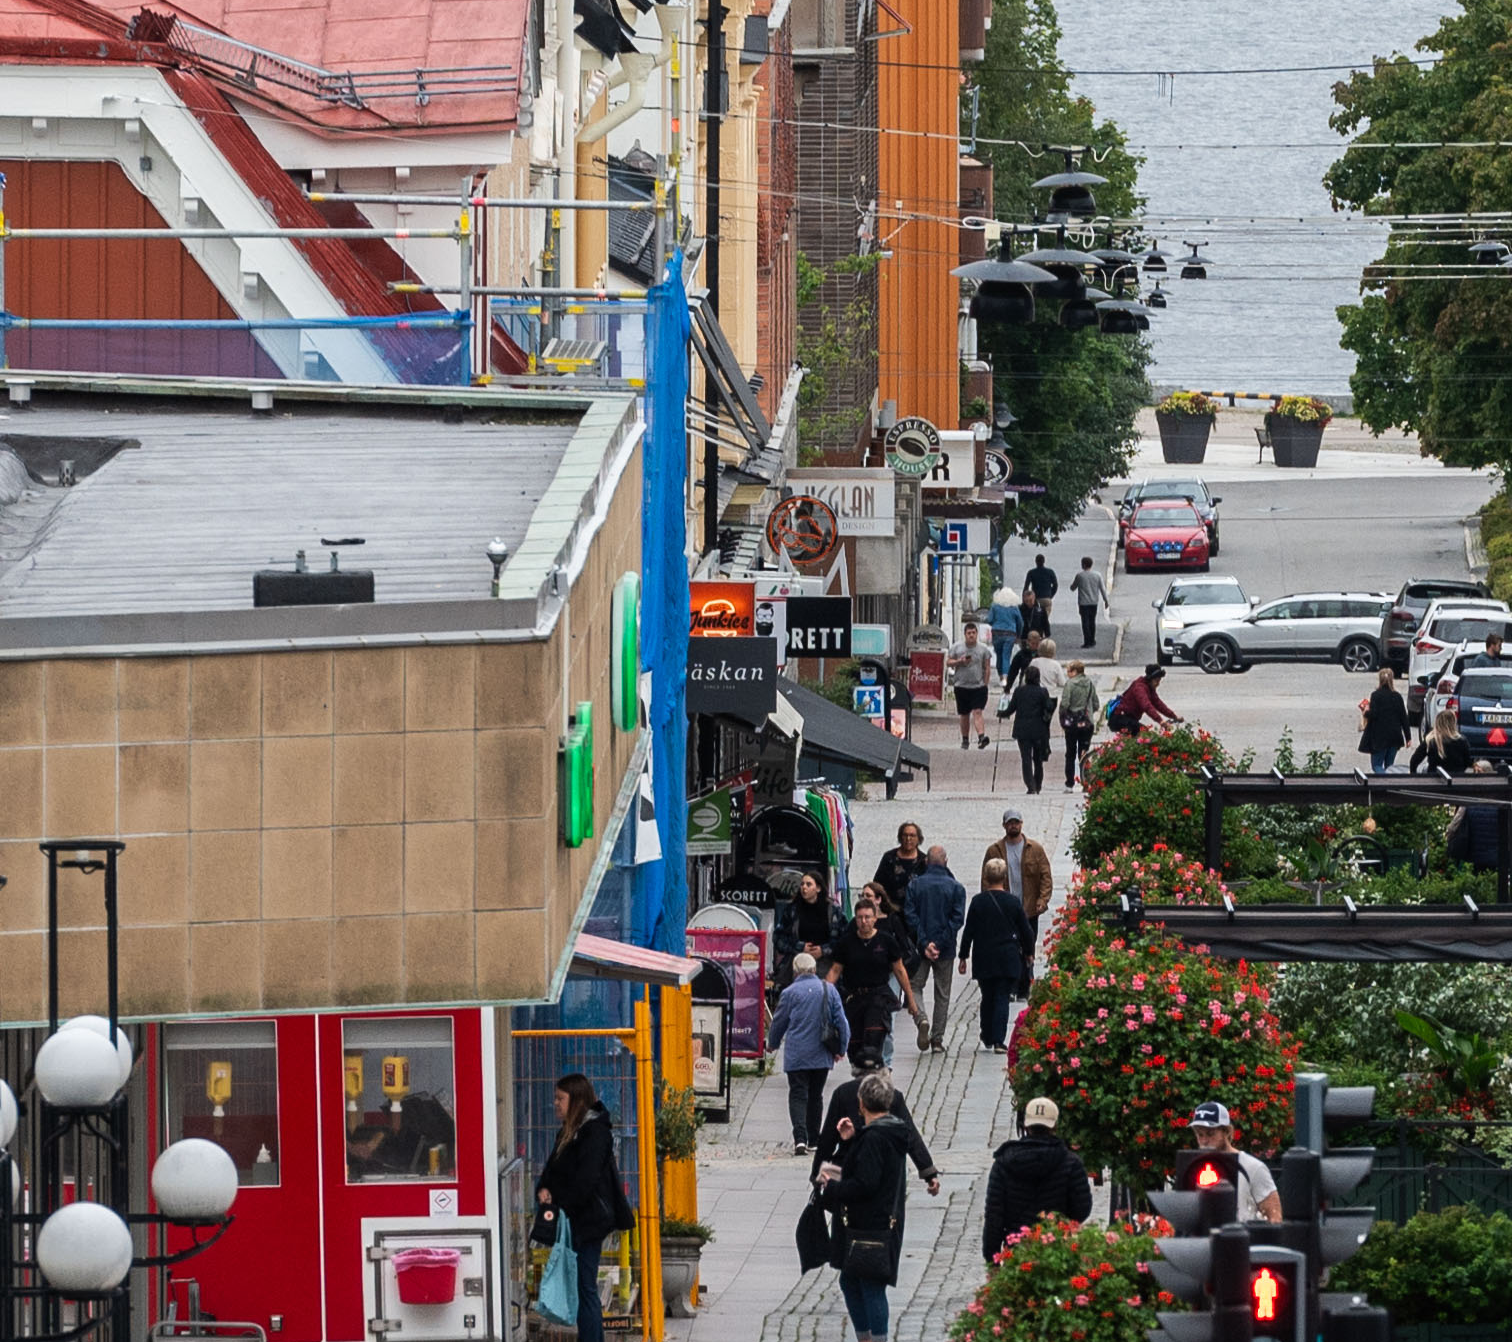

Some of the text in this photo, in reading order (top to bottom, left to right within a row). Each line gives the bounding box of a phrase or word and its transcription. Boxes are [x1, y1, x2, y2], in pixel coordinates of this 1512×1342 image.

[888, 418, 938, 443] ESPRESSO
[892, 453, 935, 475] HOUSE
[841, 521, 875, 531] DESIGN
[690, 610, 751, 632] Junkies
[785, 626, 845, 651] RETT
[720, 889, 768, 902] SCORETT
